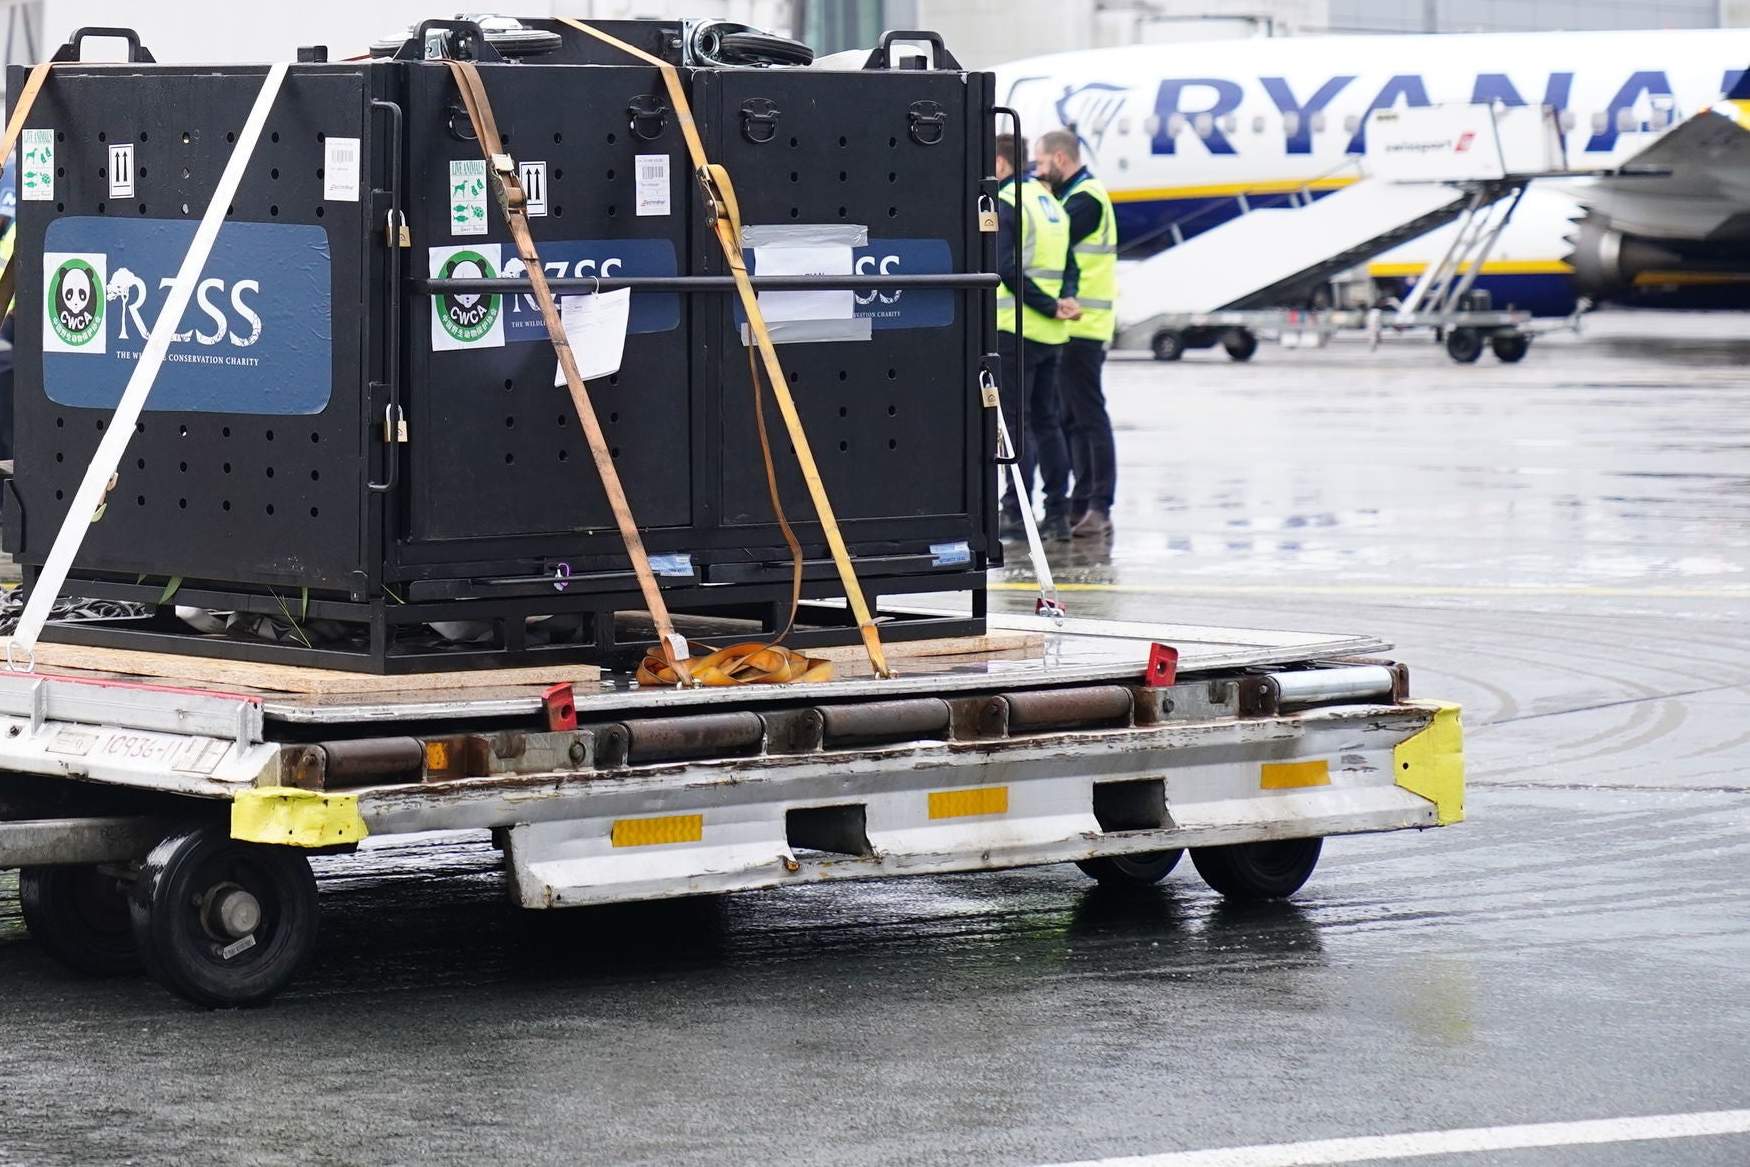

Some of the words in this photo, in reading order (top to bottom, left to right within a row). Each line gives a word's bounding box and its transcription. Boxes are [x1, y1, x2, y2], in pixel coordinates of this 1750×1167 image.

[1150, 70, 1747, 155] RYANA
[24, 130, 33, 143] LIVE
[34, 130, 53, 144] ANIMALS
[452, 162, 463, 174] LIVE
[463, 161, 485, 174] ANIMALS
[60, 310, 92, 330] CWCA
[450, 305, 487, 325] CWCA
[116, 351, 130, 359] THE
[168, 353, 223, 364] CONSERVATION
[225, 356, 259, 366] CHARITY
[101, 734, 182, 762] 10936-11
